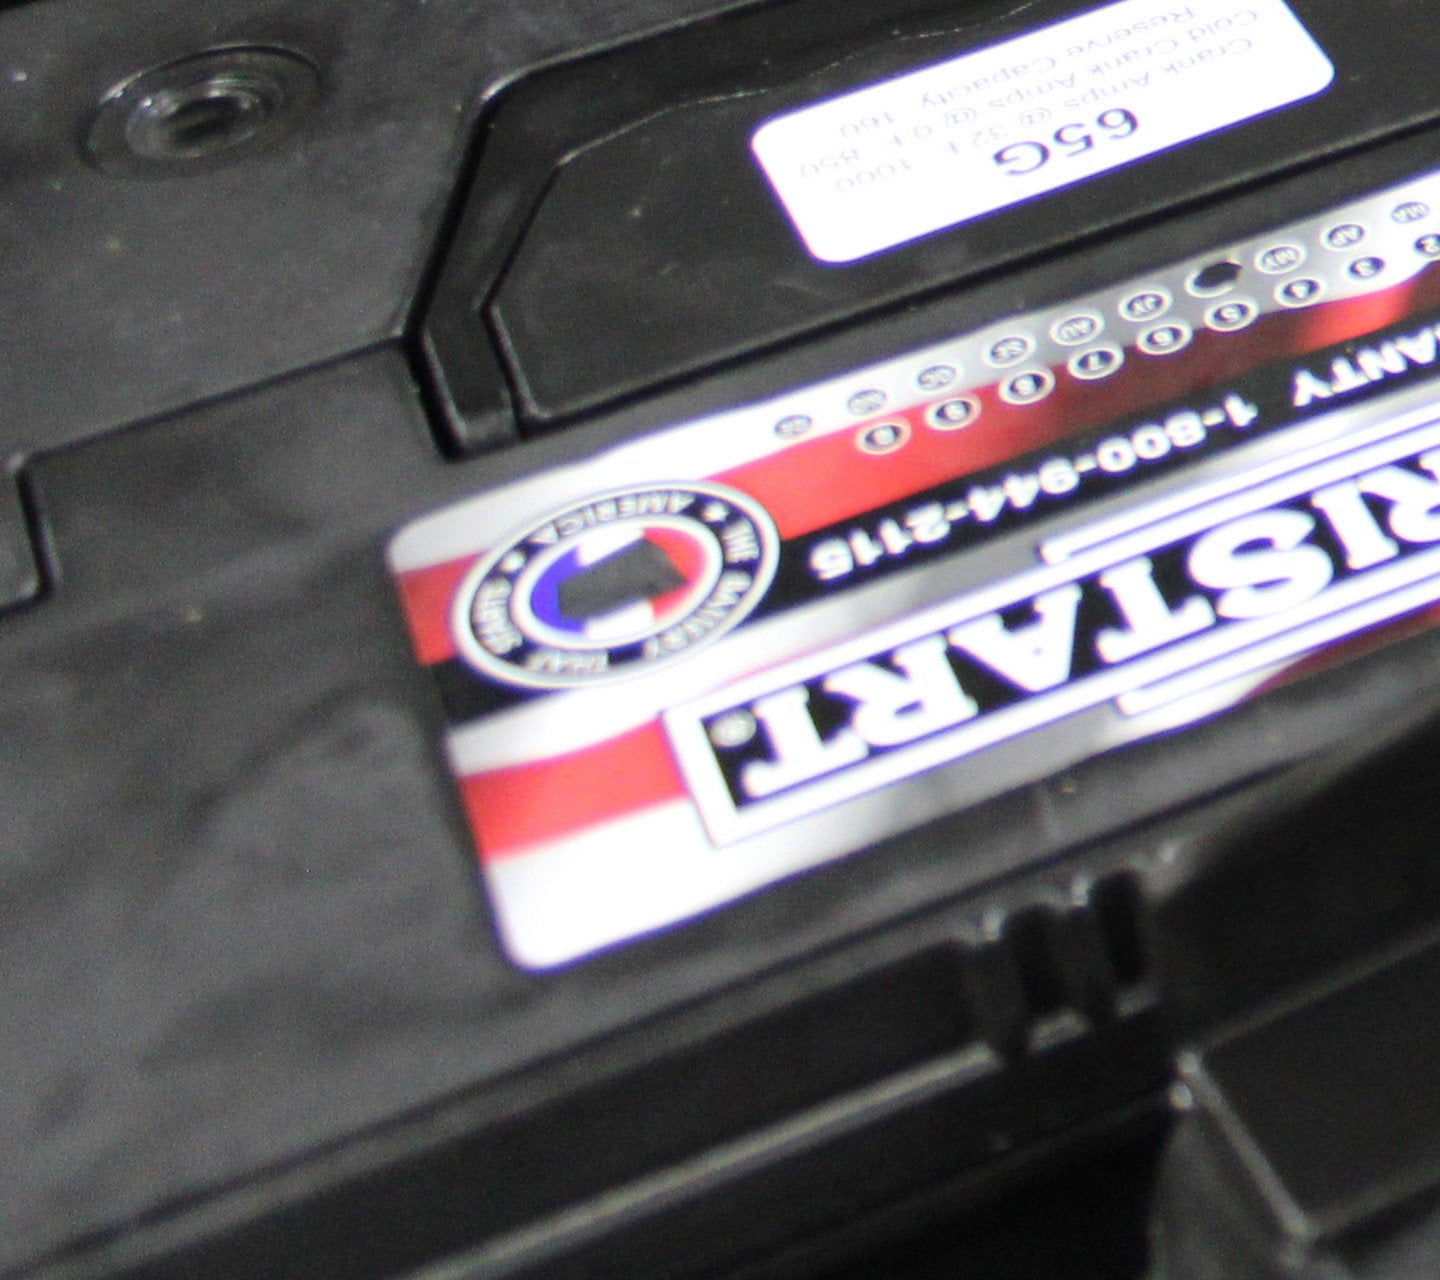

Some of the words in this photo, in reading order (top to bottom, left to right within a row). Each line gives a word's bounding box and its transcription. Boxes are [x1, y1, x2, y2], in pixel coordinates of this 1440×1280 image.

[1064, 4, 1194, 61] Reserve
[1186, 5, 1258, 43] Cold
[1084, 35, 1177, 78] Crank
[1160, 35, 1253, 76] Crank
[918, 51, 1055, 112] Capacity
[986, 71, 1076, 114] Amps
[1062, 70, 1152, 113] Amps
[990, 105, 1139, 180] 65G
[808, 400, 1260, 582] 1-800-944-2115
